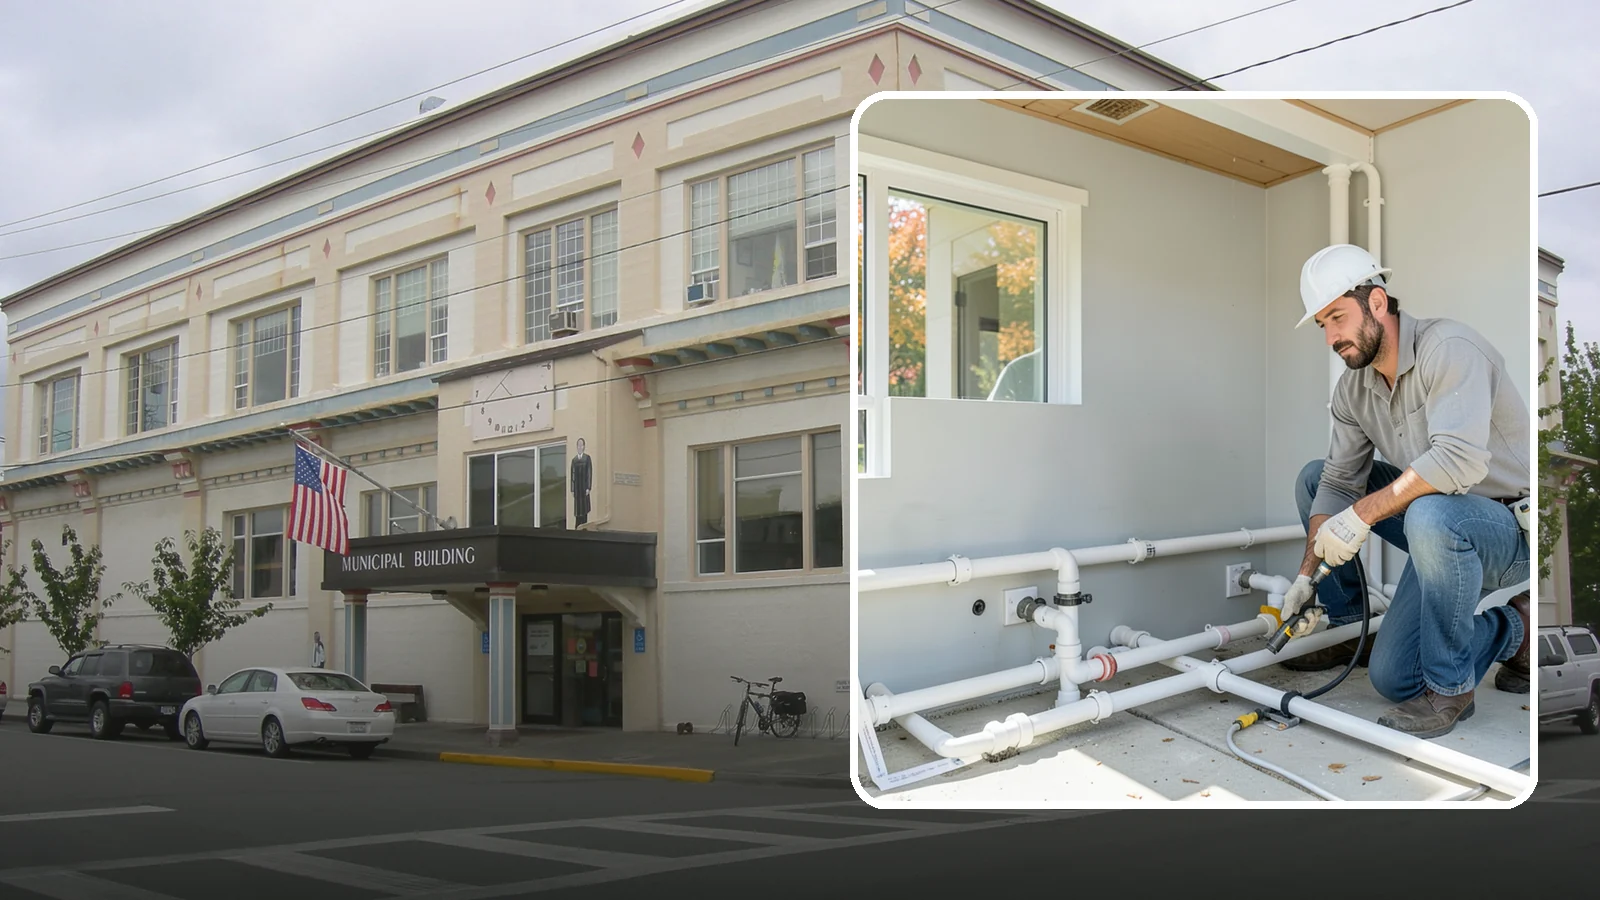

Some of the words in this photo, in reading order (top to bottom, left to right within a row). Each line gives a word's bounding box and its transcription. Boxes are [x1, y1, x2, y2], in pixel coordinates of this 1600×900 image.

[481, 407, 485, 415] 8
[488, 418, 492, 426] 9
[495, 424, 500, 432] 10
[501, 425, 506, 434] 11
[507, 425, 513, 433] 12
[521, 420, 526, 428] 2
[529, 414, 533, 422] 3
[536, 402, 540, 410] 4
[342, 552, 405, 572] MUNICIPAL
[414, 546, 475, 567] BUILDING
